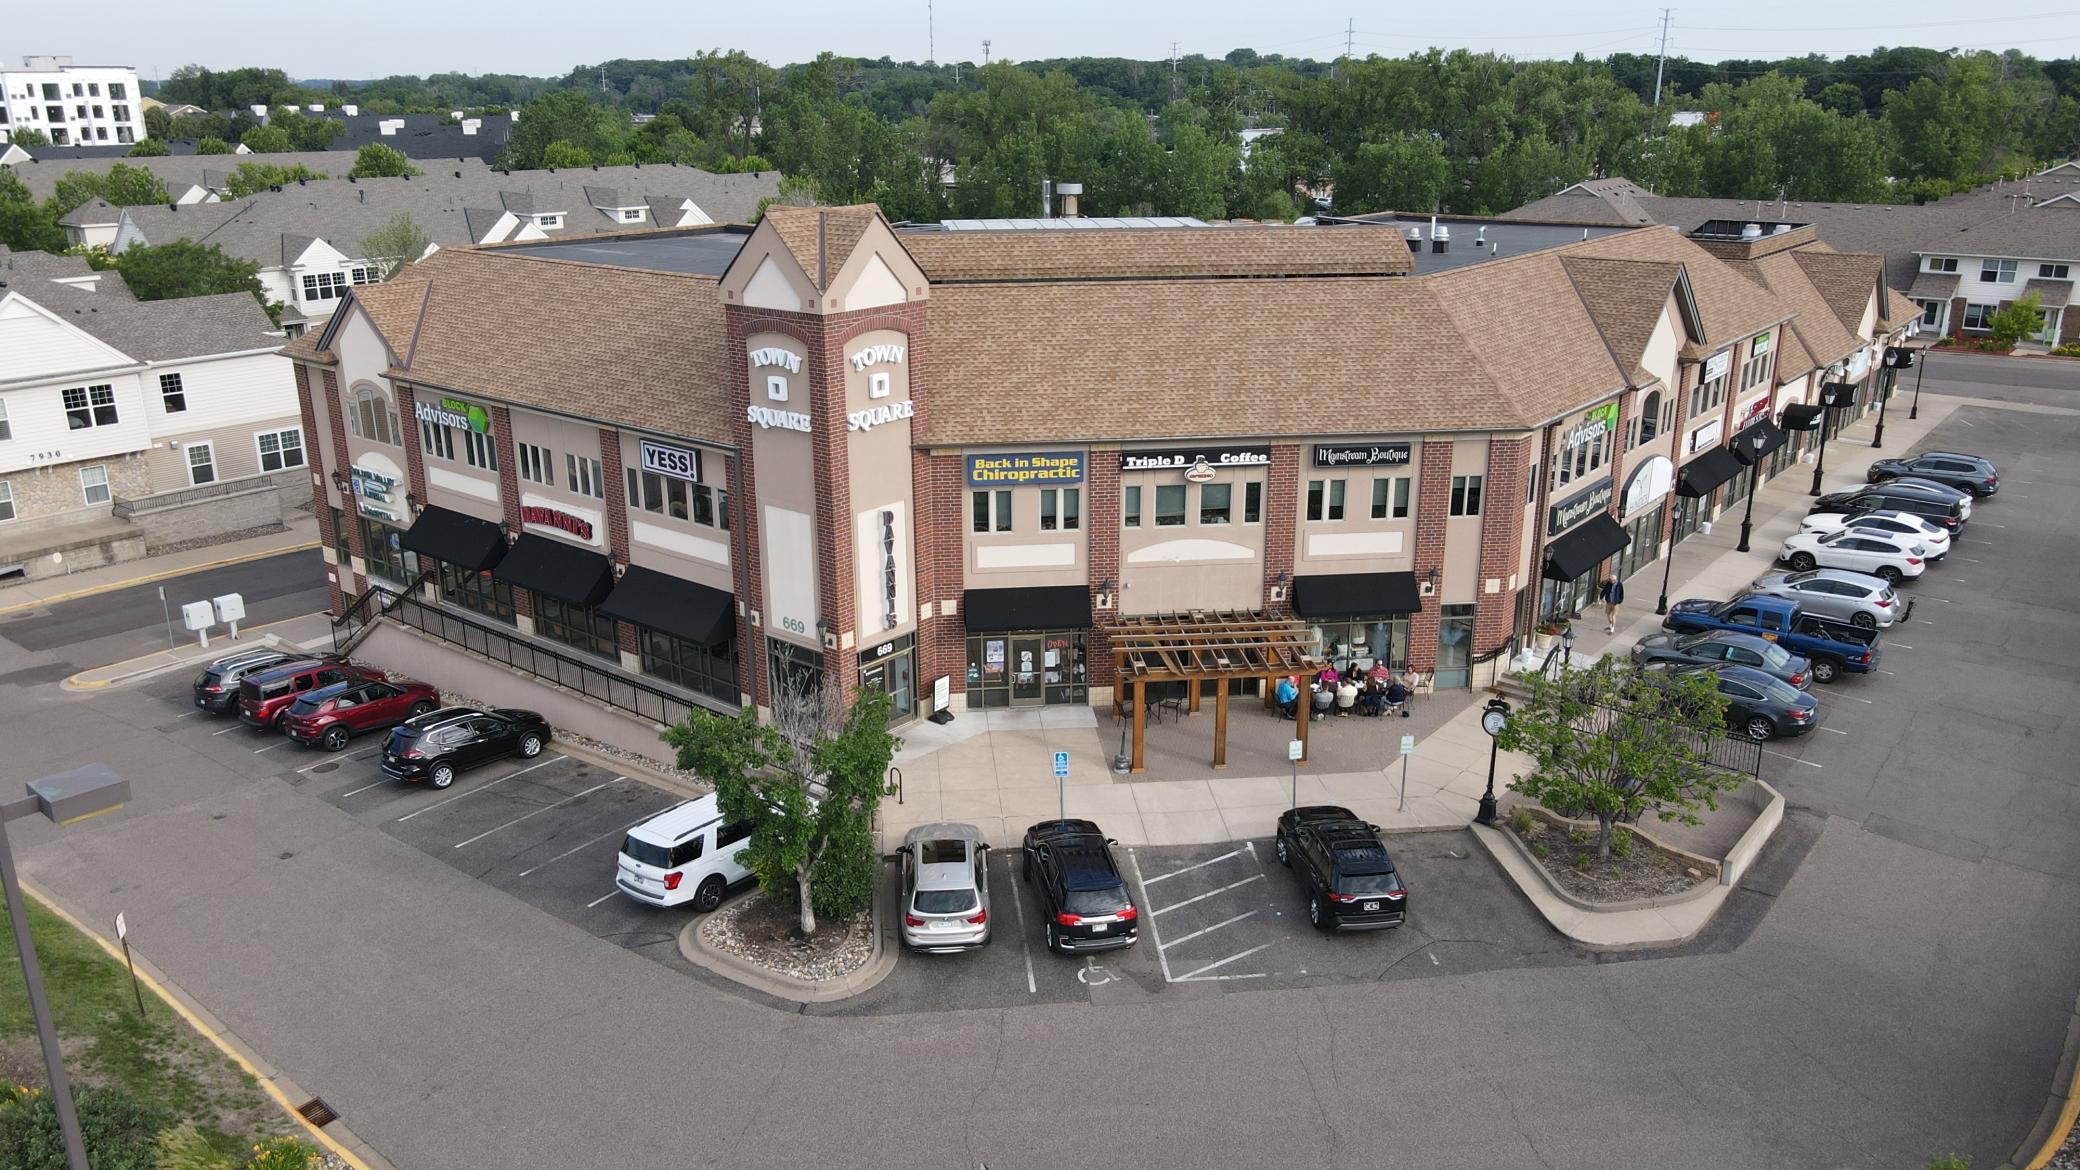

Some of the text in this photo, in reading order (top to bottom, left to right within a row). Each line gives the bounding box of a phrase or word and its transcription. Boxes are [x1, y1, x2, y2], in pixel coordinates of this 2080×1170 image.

[750, 348, 802, 374] TOWN
[850, 345, 904, 372] TOWN
[442, 399, 468, 412] BLOCK
[415, 401, 468, 430] Advisors
[748, 405, 812, 432] SQUARE
[848, 400, 914, 432] SQUARE
[1567, 419, 1606, 450] Advisors
[30, 450, 61, 462] 7930
[646, 447, 695, 479] YESS!
[975, 458, 1078, 469] Back in Shape
[1127, 452, 1268, 468] Triple D Coffee
[1320, 447, 1408, 464] Mainstream Boutique
[973, 467, 1080, 481] Chiropractic
[783, 616, 804, 633] 669
[877, 643, 893, 657] 669
